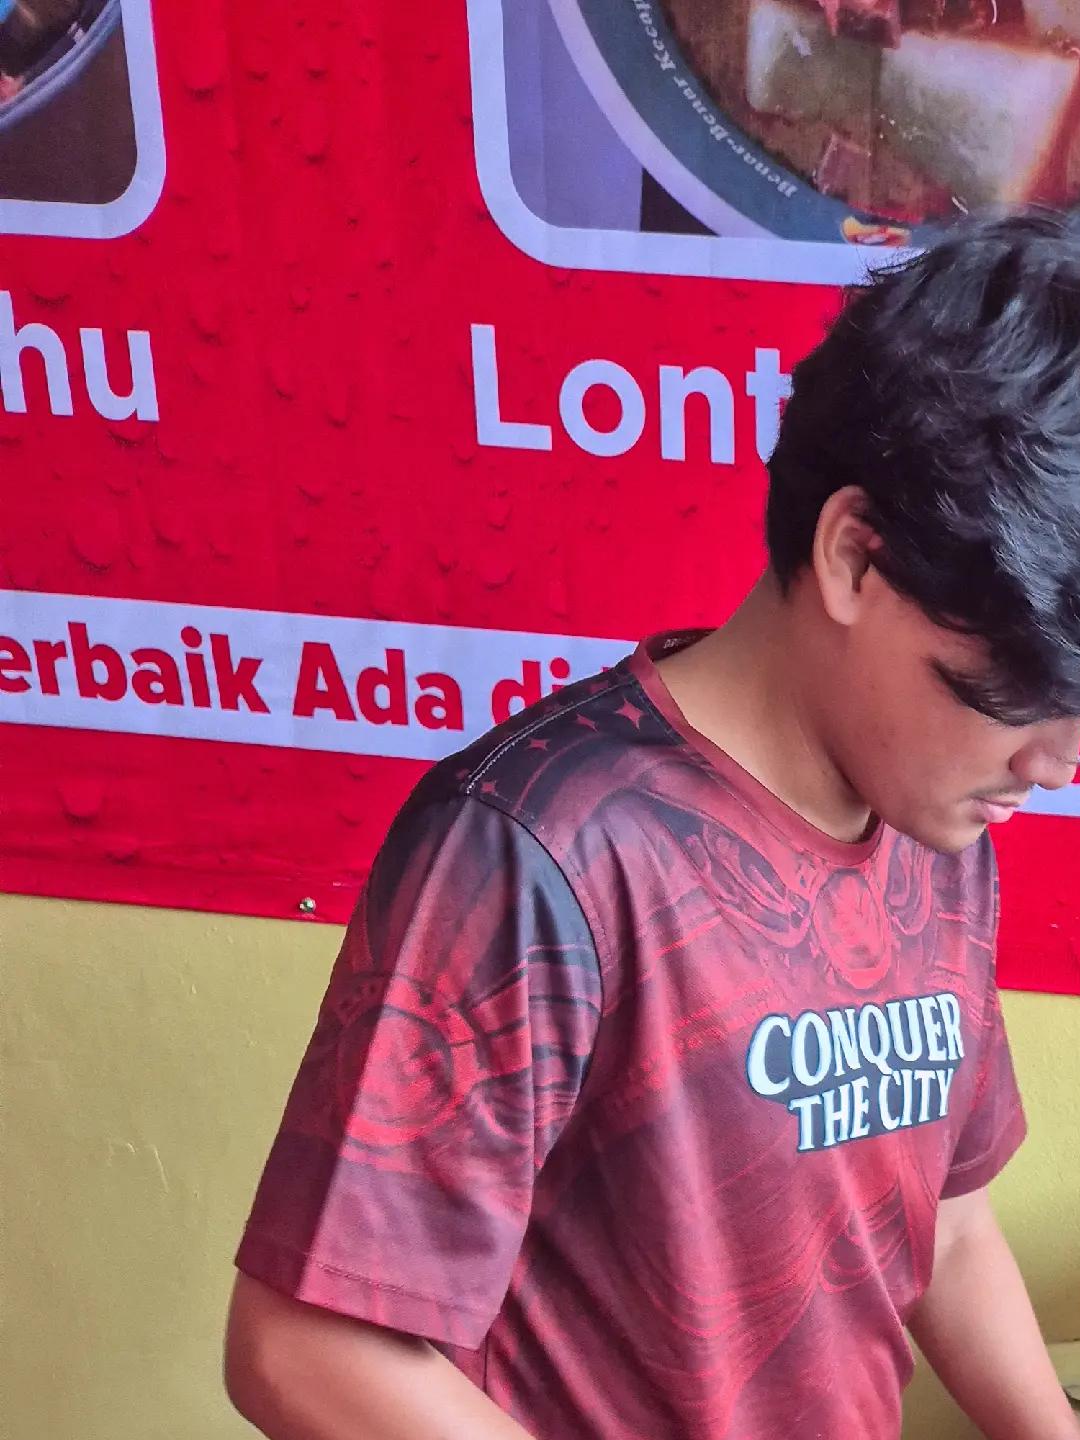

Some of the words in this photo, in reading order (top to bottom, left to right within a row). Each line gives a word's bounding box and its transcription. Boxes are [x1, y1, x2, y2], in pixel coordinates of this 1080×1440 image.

[471, 323, 793, 465] Lont
[293, 641, 464, 731] Ada
[747, 992, 965, 1096] CONQUER
[788, 1076, 870, 1151] THE
[878, 1067, 954, 1131] CITY
